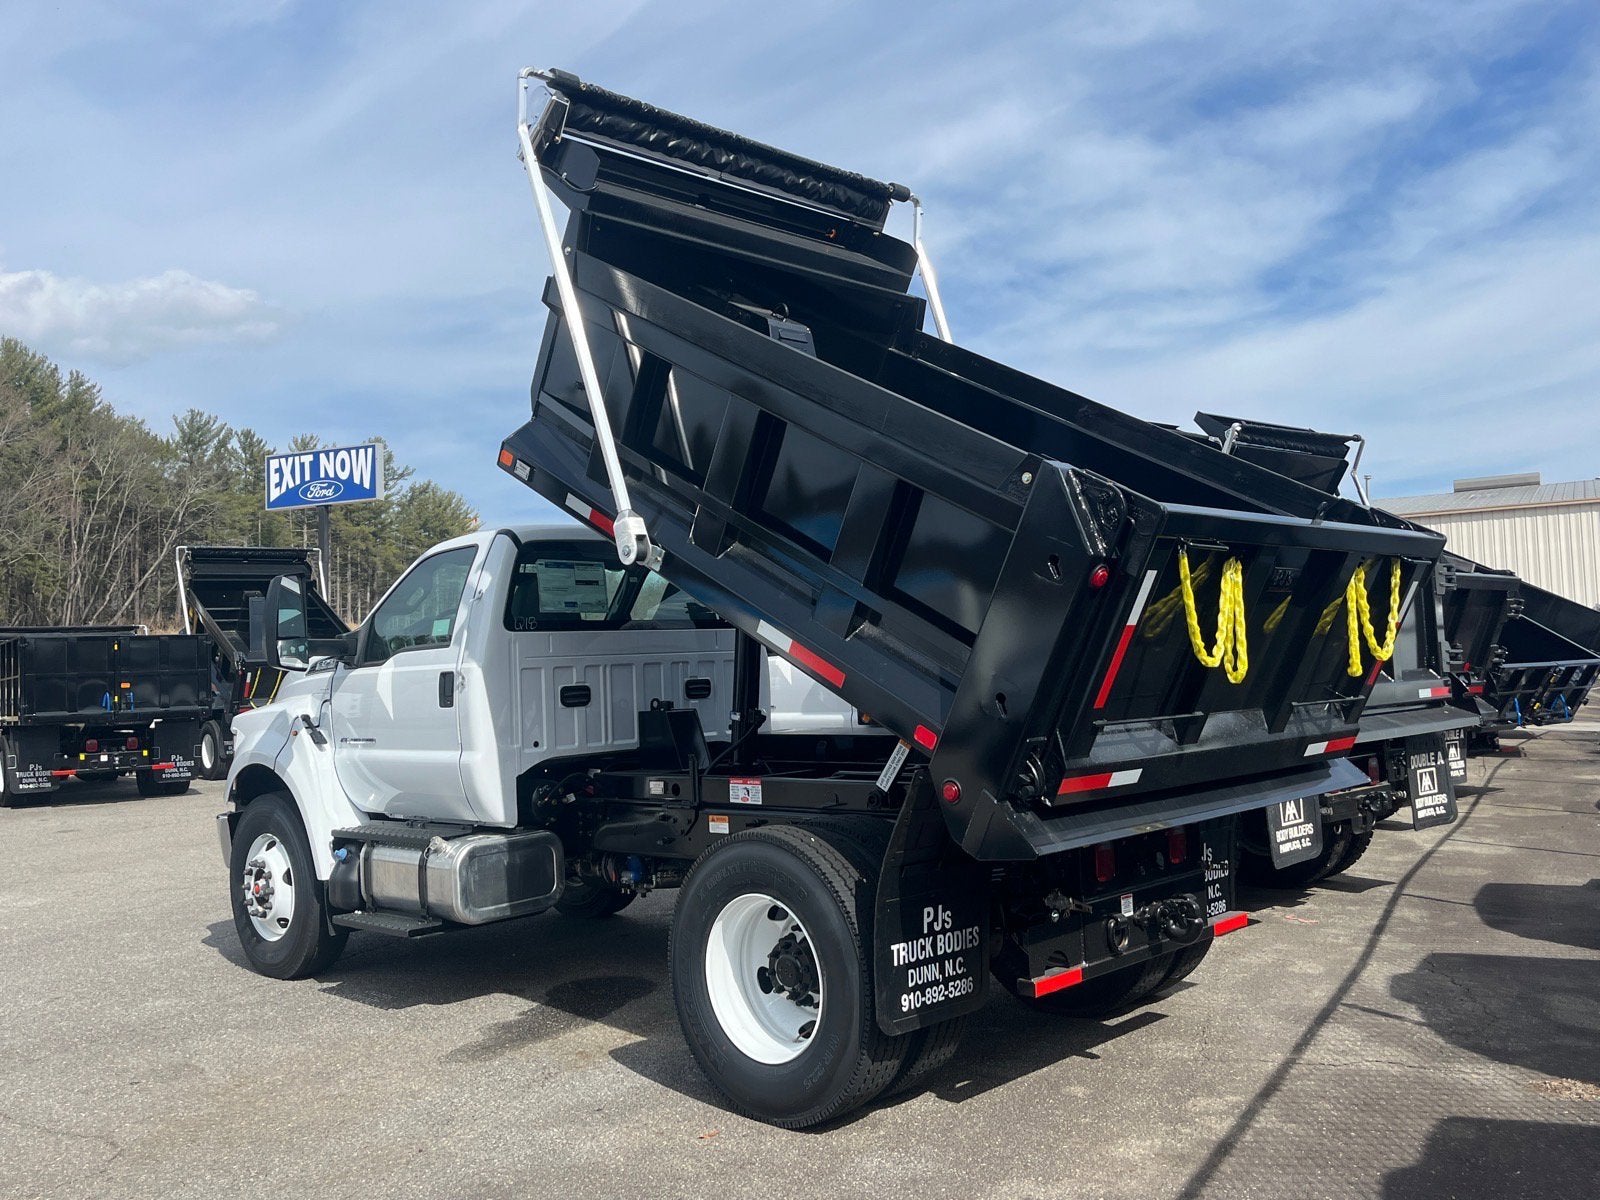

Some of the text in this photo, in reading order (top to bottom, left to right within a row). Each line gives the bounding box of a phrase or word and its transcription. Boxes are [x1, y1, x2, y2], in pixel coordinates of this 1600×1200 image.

[269, 447, 372, 502] EXIT NOW
[307, 483, 334, 498] Ford
[1443, 729, 1459, 740] OUBLE
[1410, 752, 1436, 769] DOUBLE
[1437, 751, 1445, 765] A
[1208, 883, 1222, 899] N.C.
[890, 925, 980, 966] TRUCK BODIES
[908, 956, 967, 987] DUNN, N.C.
[901, 976, 974, 1012] 910-892-5286
